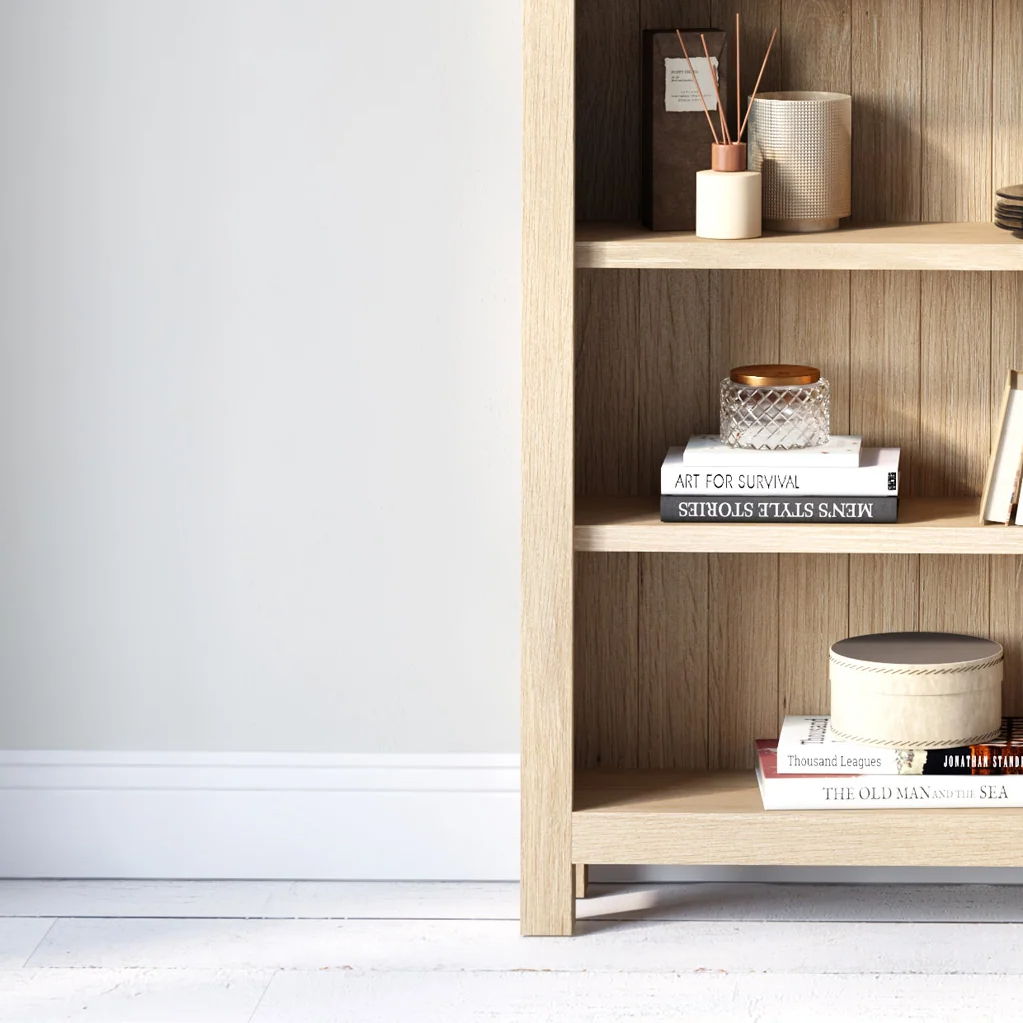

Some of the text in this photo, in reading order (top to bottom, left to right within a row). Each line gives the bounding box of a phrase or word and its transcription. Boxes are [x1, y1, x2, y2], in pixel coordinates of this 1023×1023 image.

[675, 474, 800, 489] ART FOR SURVIVAL
[678, 501, 874, 518] MEN'S STYLE STORIES
[787, 754, 882, 769] Thousand Leagues
[943, 755, 989, 768] JONATHAN
[822, 785, 1009, 800] THE OLD MAN AND THE SEA
